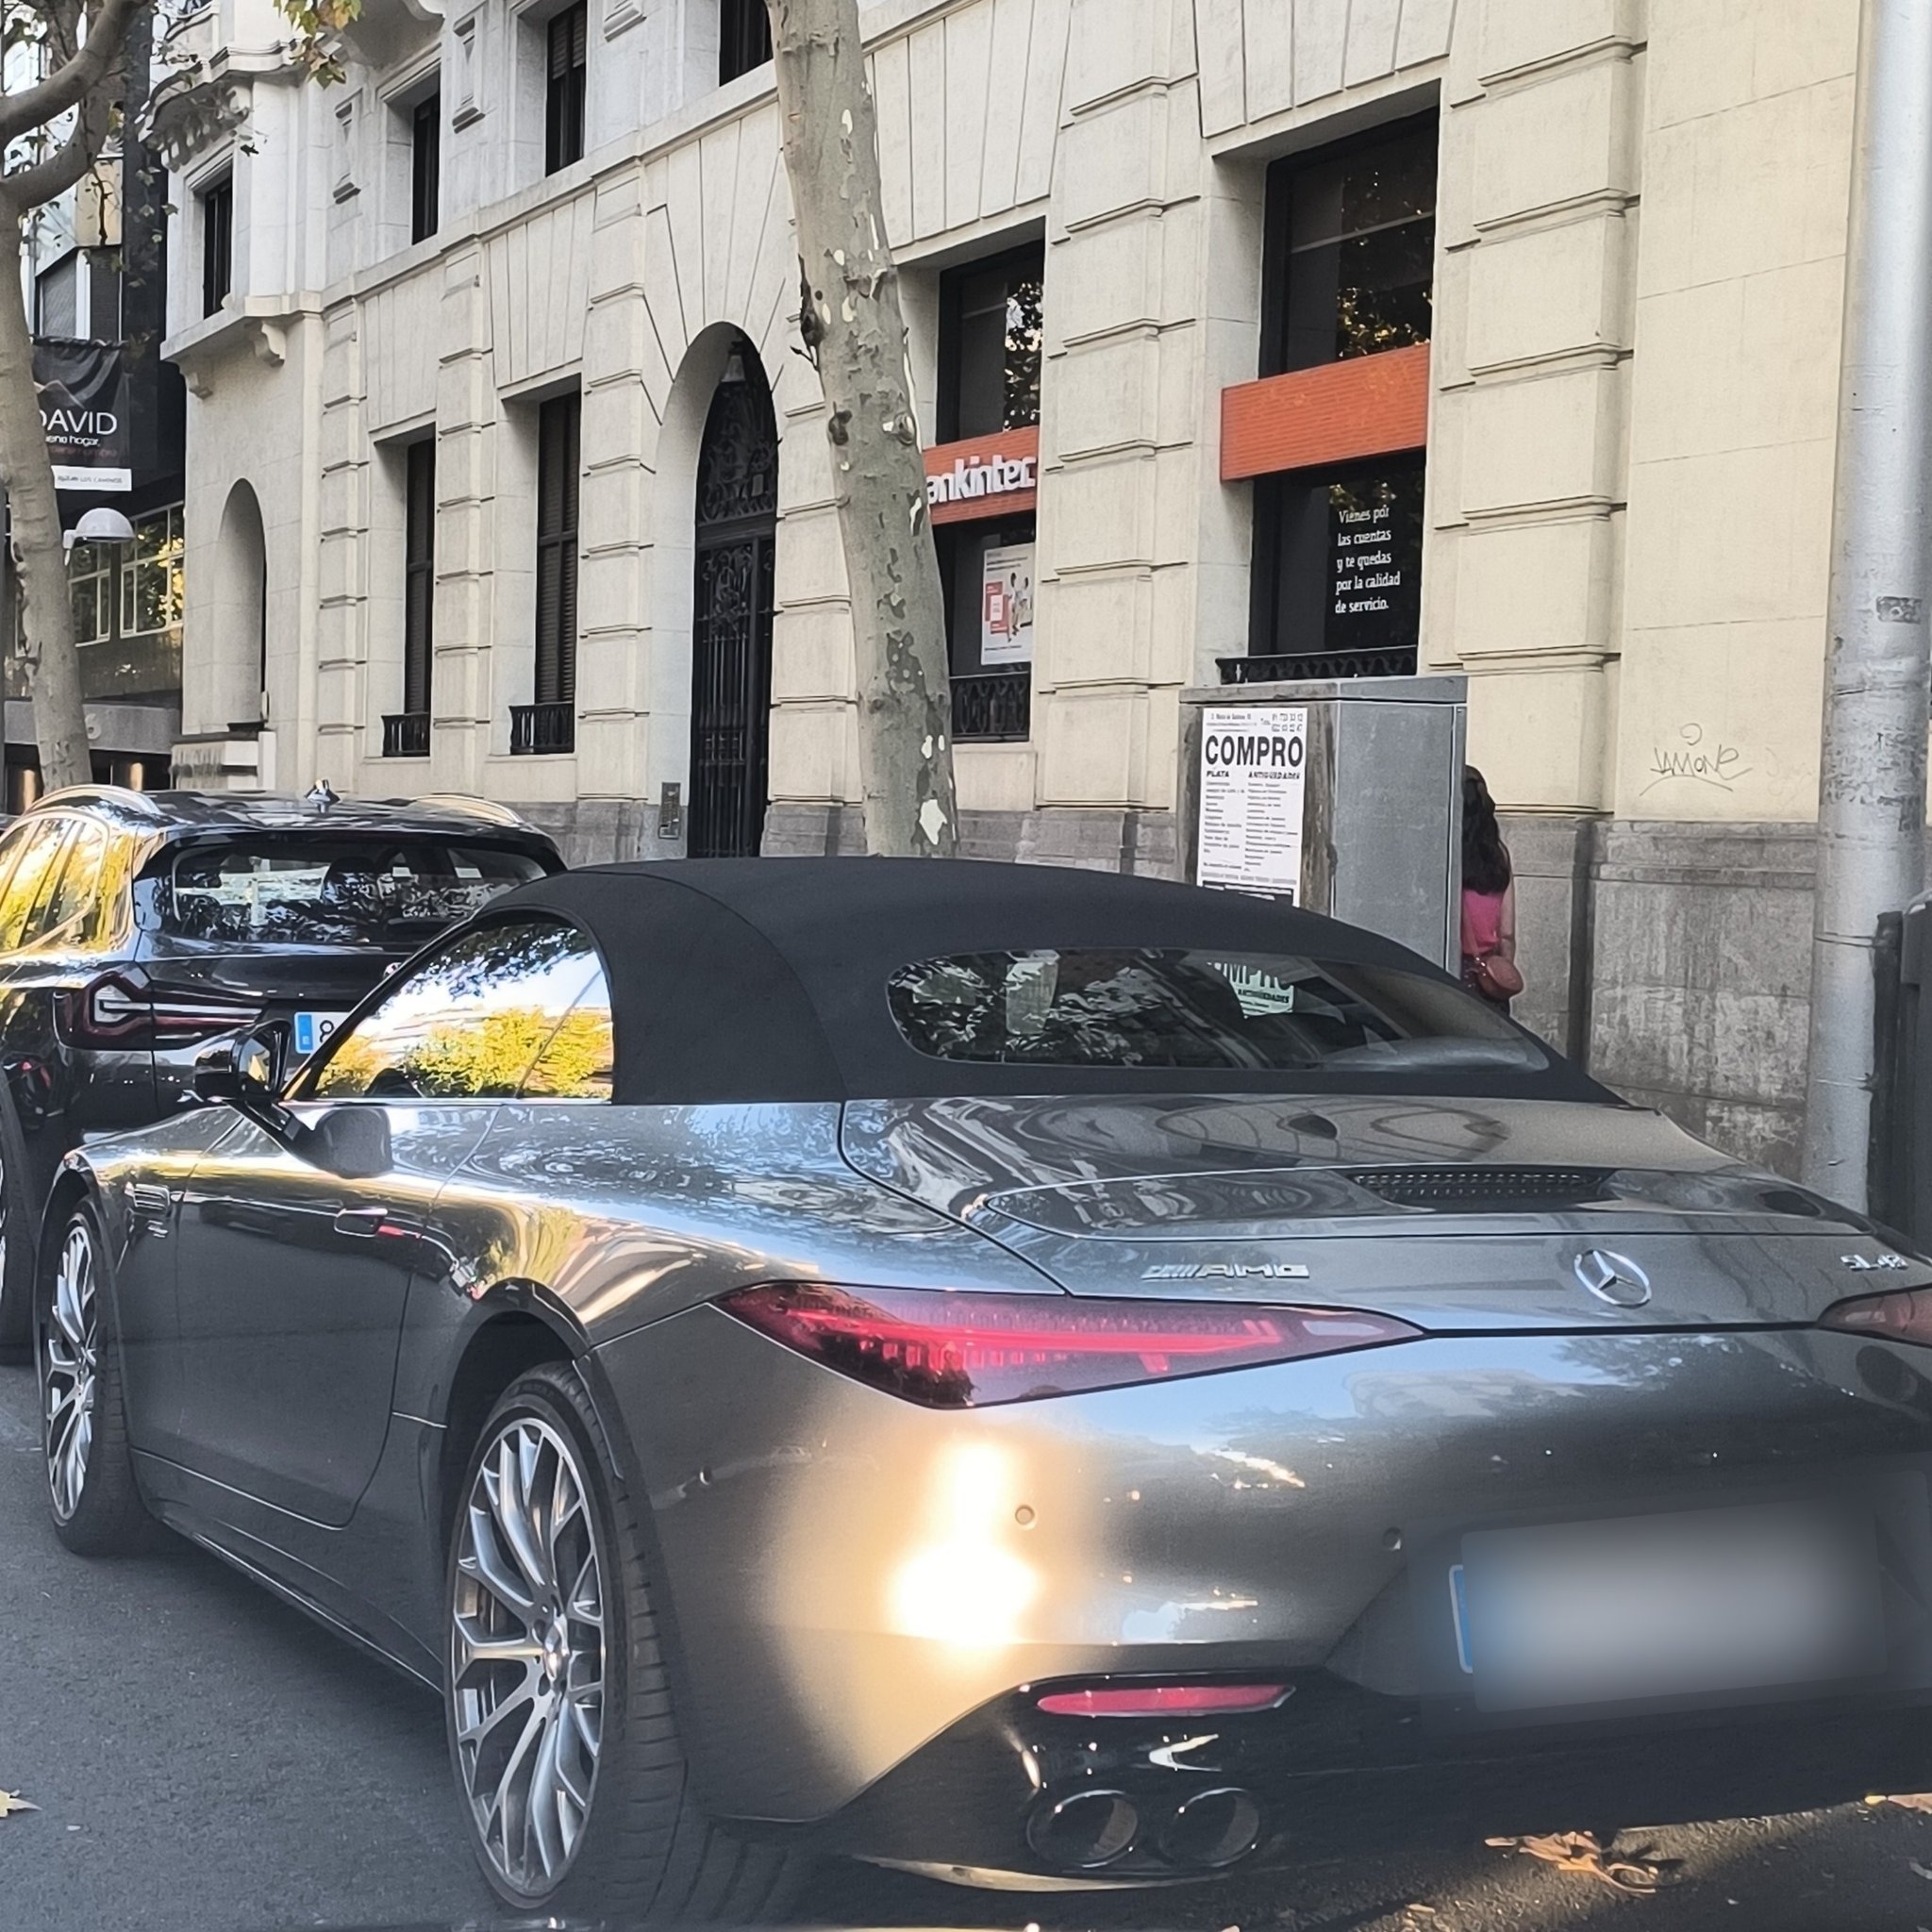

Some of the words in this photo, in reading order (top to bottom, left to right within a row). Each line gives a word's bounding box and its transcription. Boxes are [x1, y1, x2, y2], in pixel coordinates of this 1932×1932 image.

[1339, 509, 1371, 524] Vienes
[1373, 507, 1390, 524] por
[1338, 533, 1351, 546] las
[1354, 530, 1391, 544] cuentas
[1337, 558, 1343, 573] y
[1345, 557, 1356, 568] te
[1357, 550, 1391, 571] quedas
[1335, 579, 1352, 595] por
[1354, 575, 1363, 590] la
[1365, 571, 1401, 588] calidad
[1335, 599, 1346, 613] de
[1349, 596, 1389, 612] servicio.
[1206, 735, 1303, 767] COMPRO
[1194, 1263, 1310, 1279] AMG
